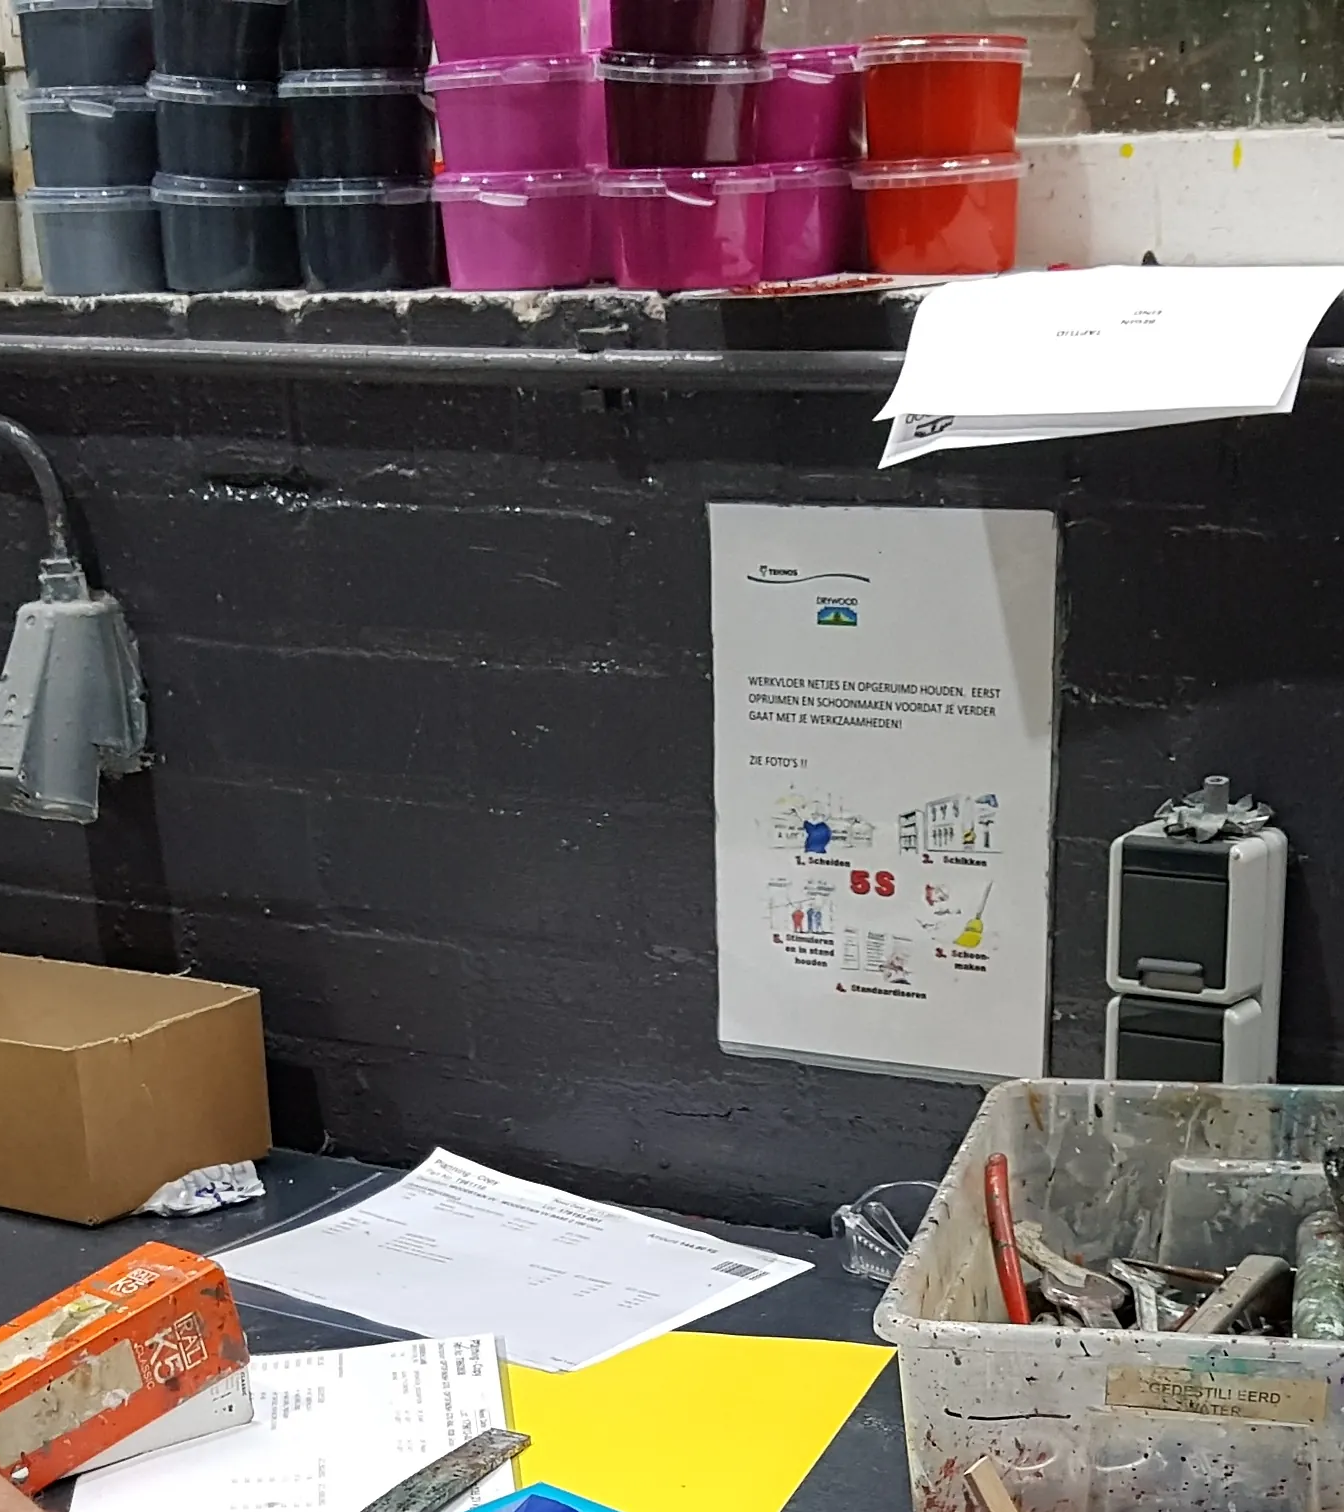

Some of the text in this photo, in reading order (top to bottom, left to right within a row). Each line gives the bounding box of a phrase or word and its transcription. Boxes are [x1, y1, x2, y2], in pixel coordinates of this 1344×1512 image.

[769, 568, 798, 577] TEKNOS
[816, 596, 858, 606] DRYWOOD
[748, 676, 805, 689] WERKVLOER
[808, 679, 840, 690] NETJES
[843, 681, 855, 691] EN
[858, 681, 918, 695] OPGERUIMD
[971, 687, 1002, 699] EERST
[748, 693, 996, 717] OPRUIMEN EN SCHOONMAKEN VOORDAT JE VERDER
[749, 710, 902, 729] GAAT MET JE WERKZAAMHEDEN!
[749, 755, 762, 766] ZIE
[765, 756, 798, 768] FOTO'S
[808, 856, 851, 868] Scheiden
[943, 855, 987, 867] Schikken
[809, 947, 835, 957] stand
[795, 957, 828, 967] houden
[955, 962, 986, 973] maken
[851, 984, 927, 1000] Standaardiseren
[176, 1314, 205, 1368] RAL
[145, 1327, 184, 1384] K5
[133, 1343, 155, 1390] CLASSIC
